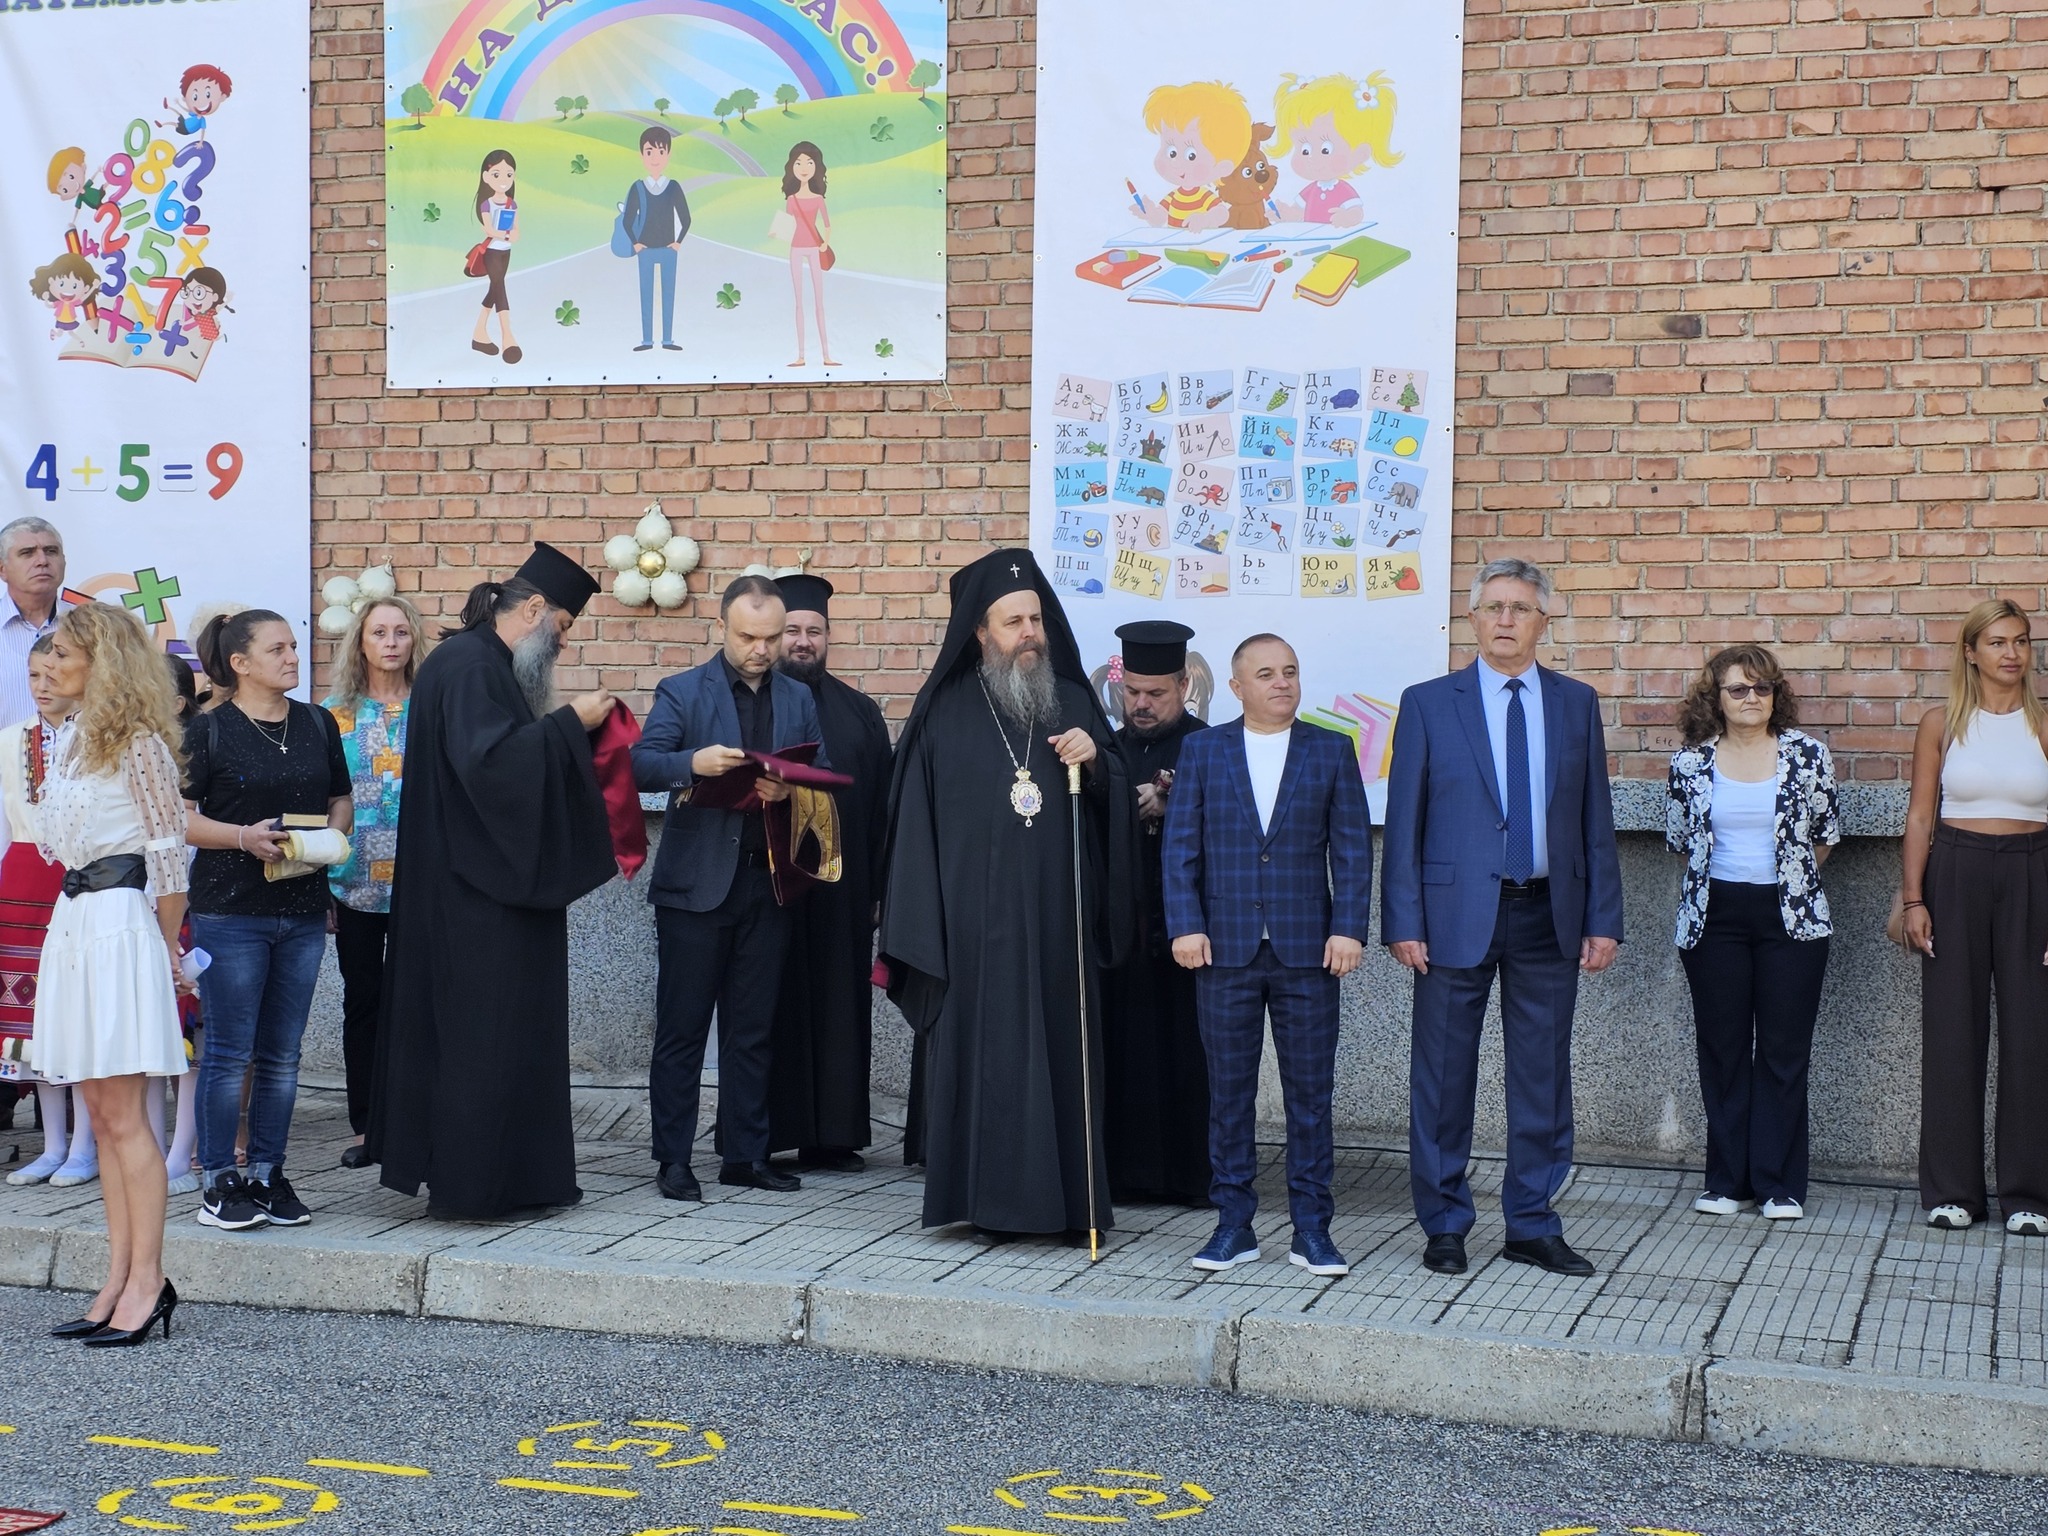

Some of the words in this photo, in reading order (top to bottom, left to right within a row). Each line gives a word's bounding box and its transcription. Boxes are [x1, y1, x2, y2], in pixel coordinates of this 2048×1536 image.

[439, 28, 514, 112] НА
[782, 0, 894, 86] АС!
[94, 201, 129, 254] 2
[155, 180, 184, 231] 6
[100, 249, 126, 297] 3
[130, 227, 175, 285] 5
[147, 277, 184, 330] 7
